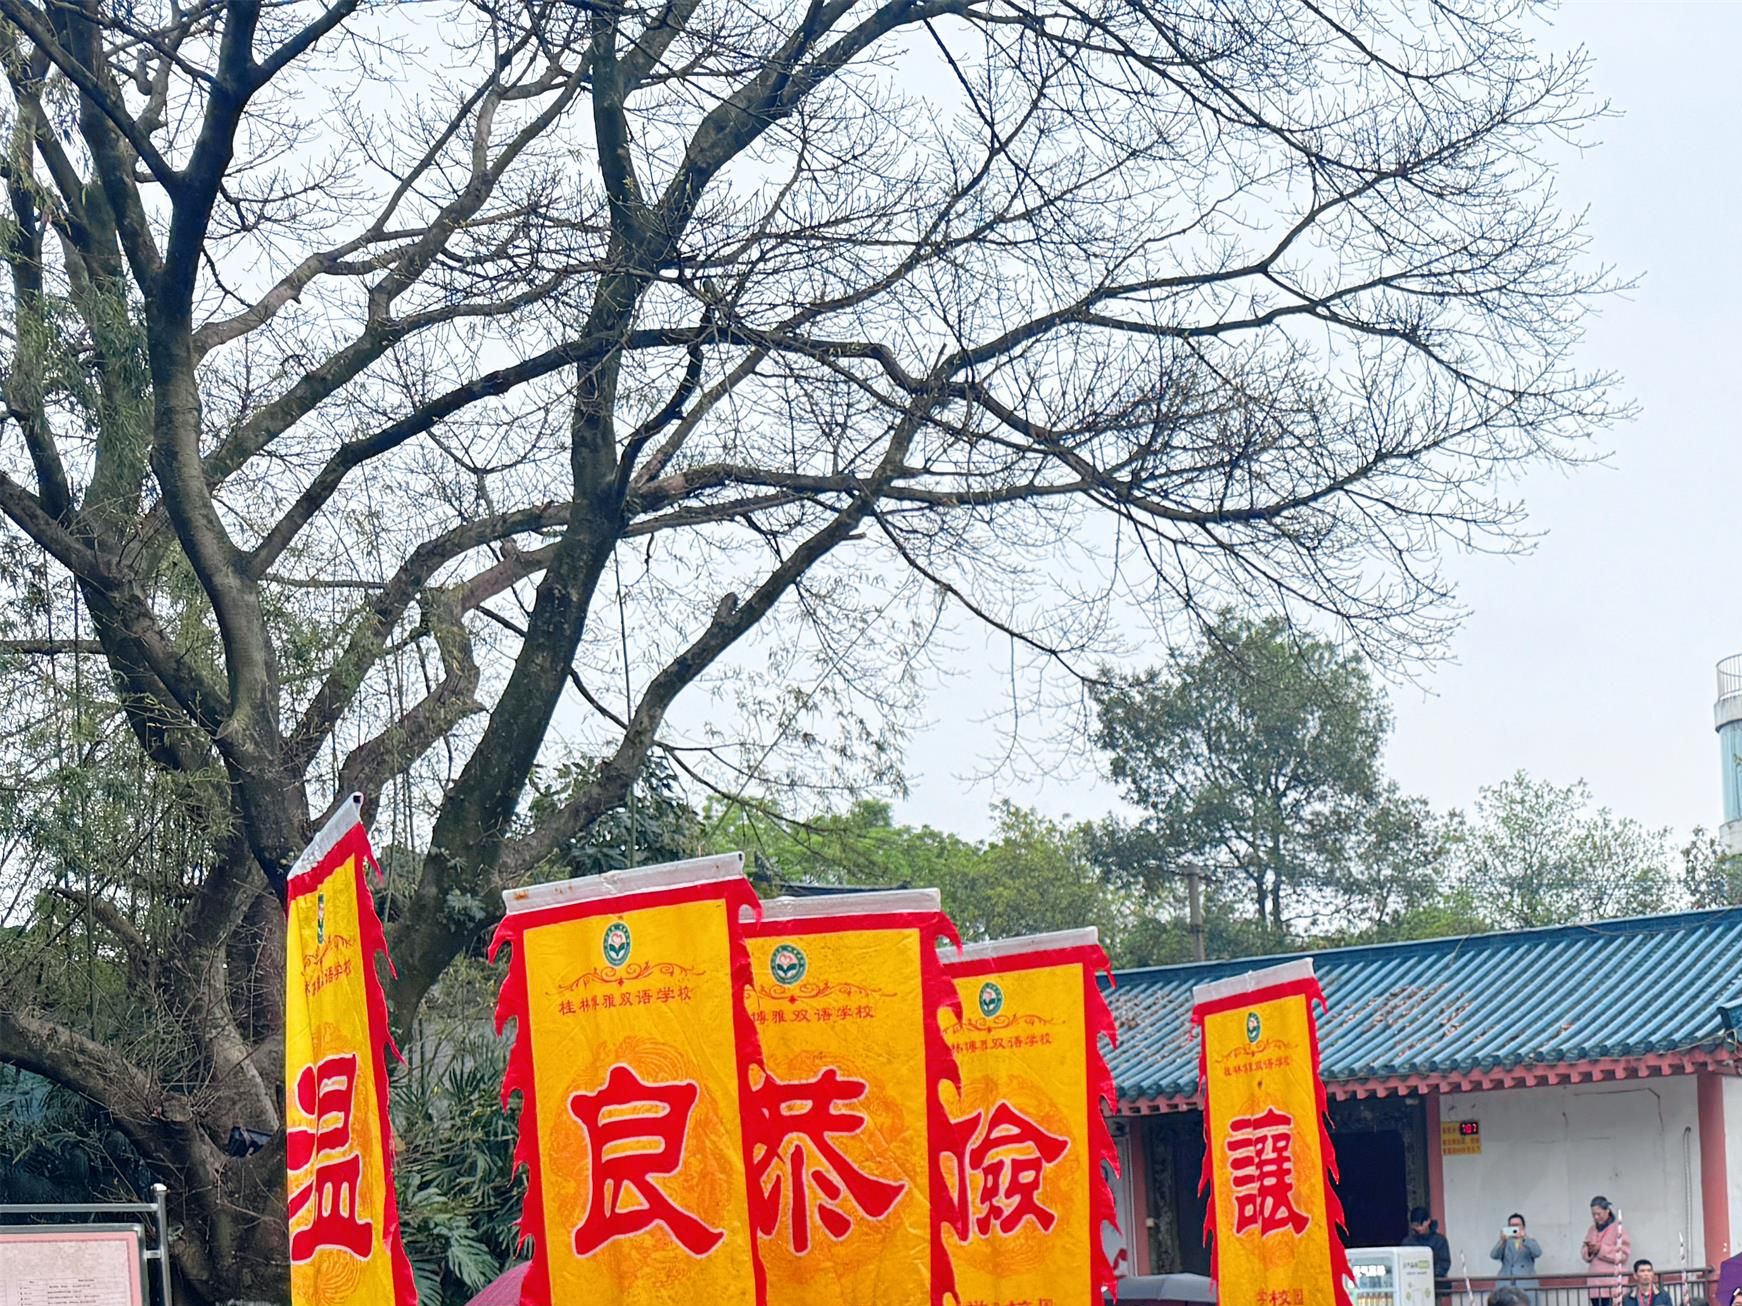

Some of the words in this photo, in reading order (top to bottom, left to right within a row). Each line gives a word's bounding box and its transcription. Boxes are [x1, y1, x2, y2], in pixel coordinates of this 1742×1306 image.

[287, 1053, 372, 1263] 温
[569, 1063, 725, 1257] 良
[754, 1066, 907, 1255] 恭
